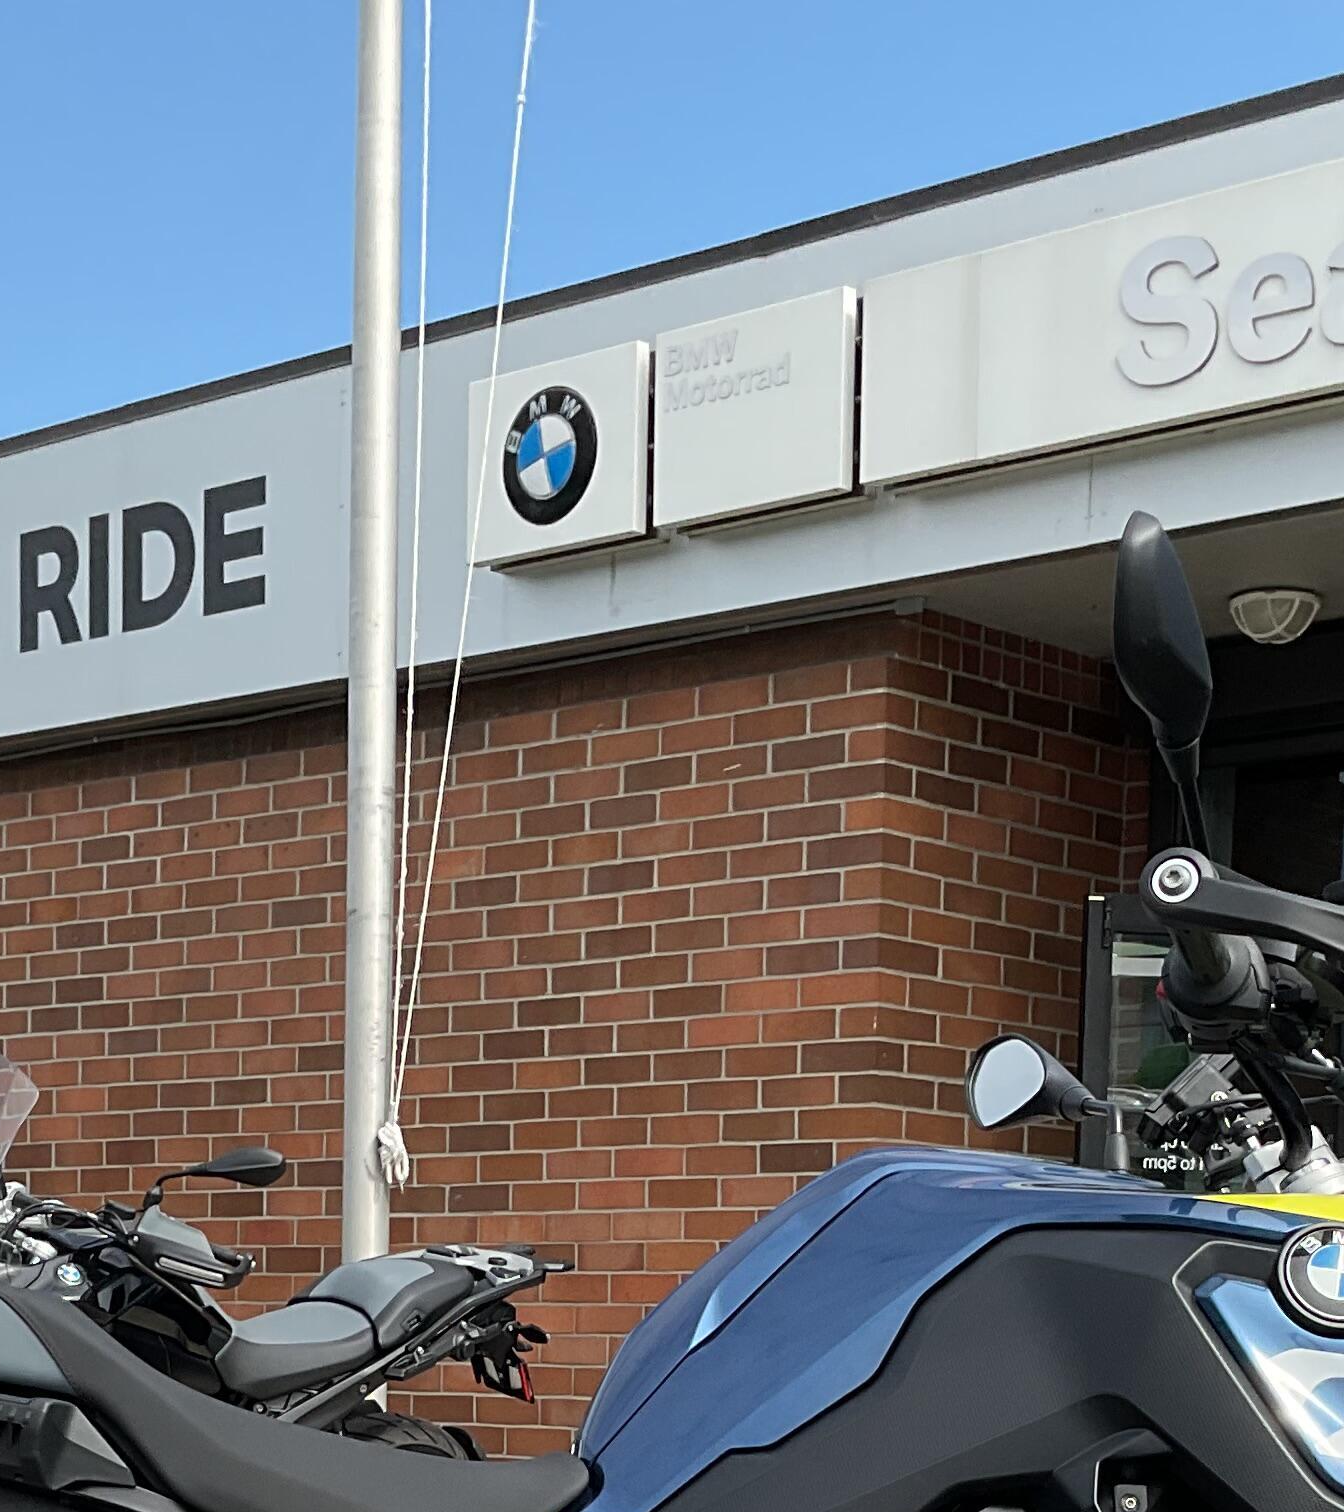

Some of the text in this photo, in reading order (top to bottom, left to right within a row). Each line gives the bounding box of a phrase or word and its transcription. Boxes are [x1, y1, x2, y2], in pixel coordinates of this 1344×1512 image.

[663, 328, 739, 378] BMW
[663, 351, 791, 413] Motorrad
[20, 475, 267, 654] RIDE
